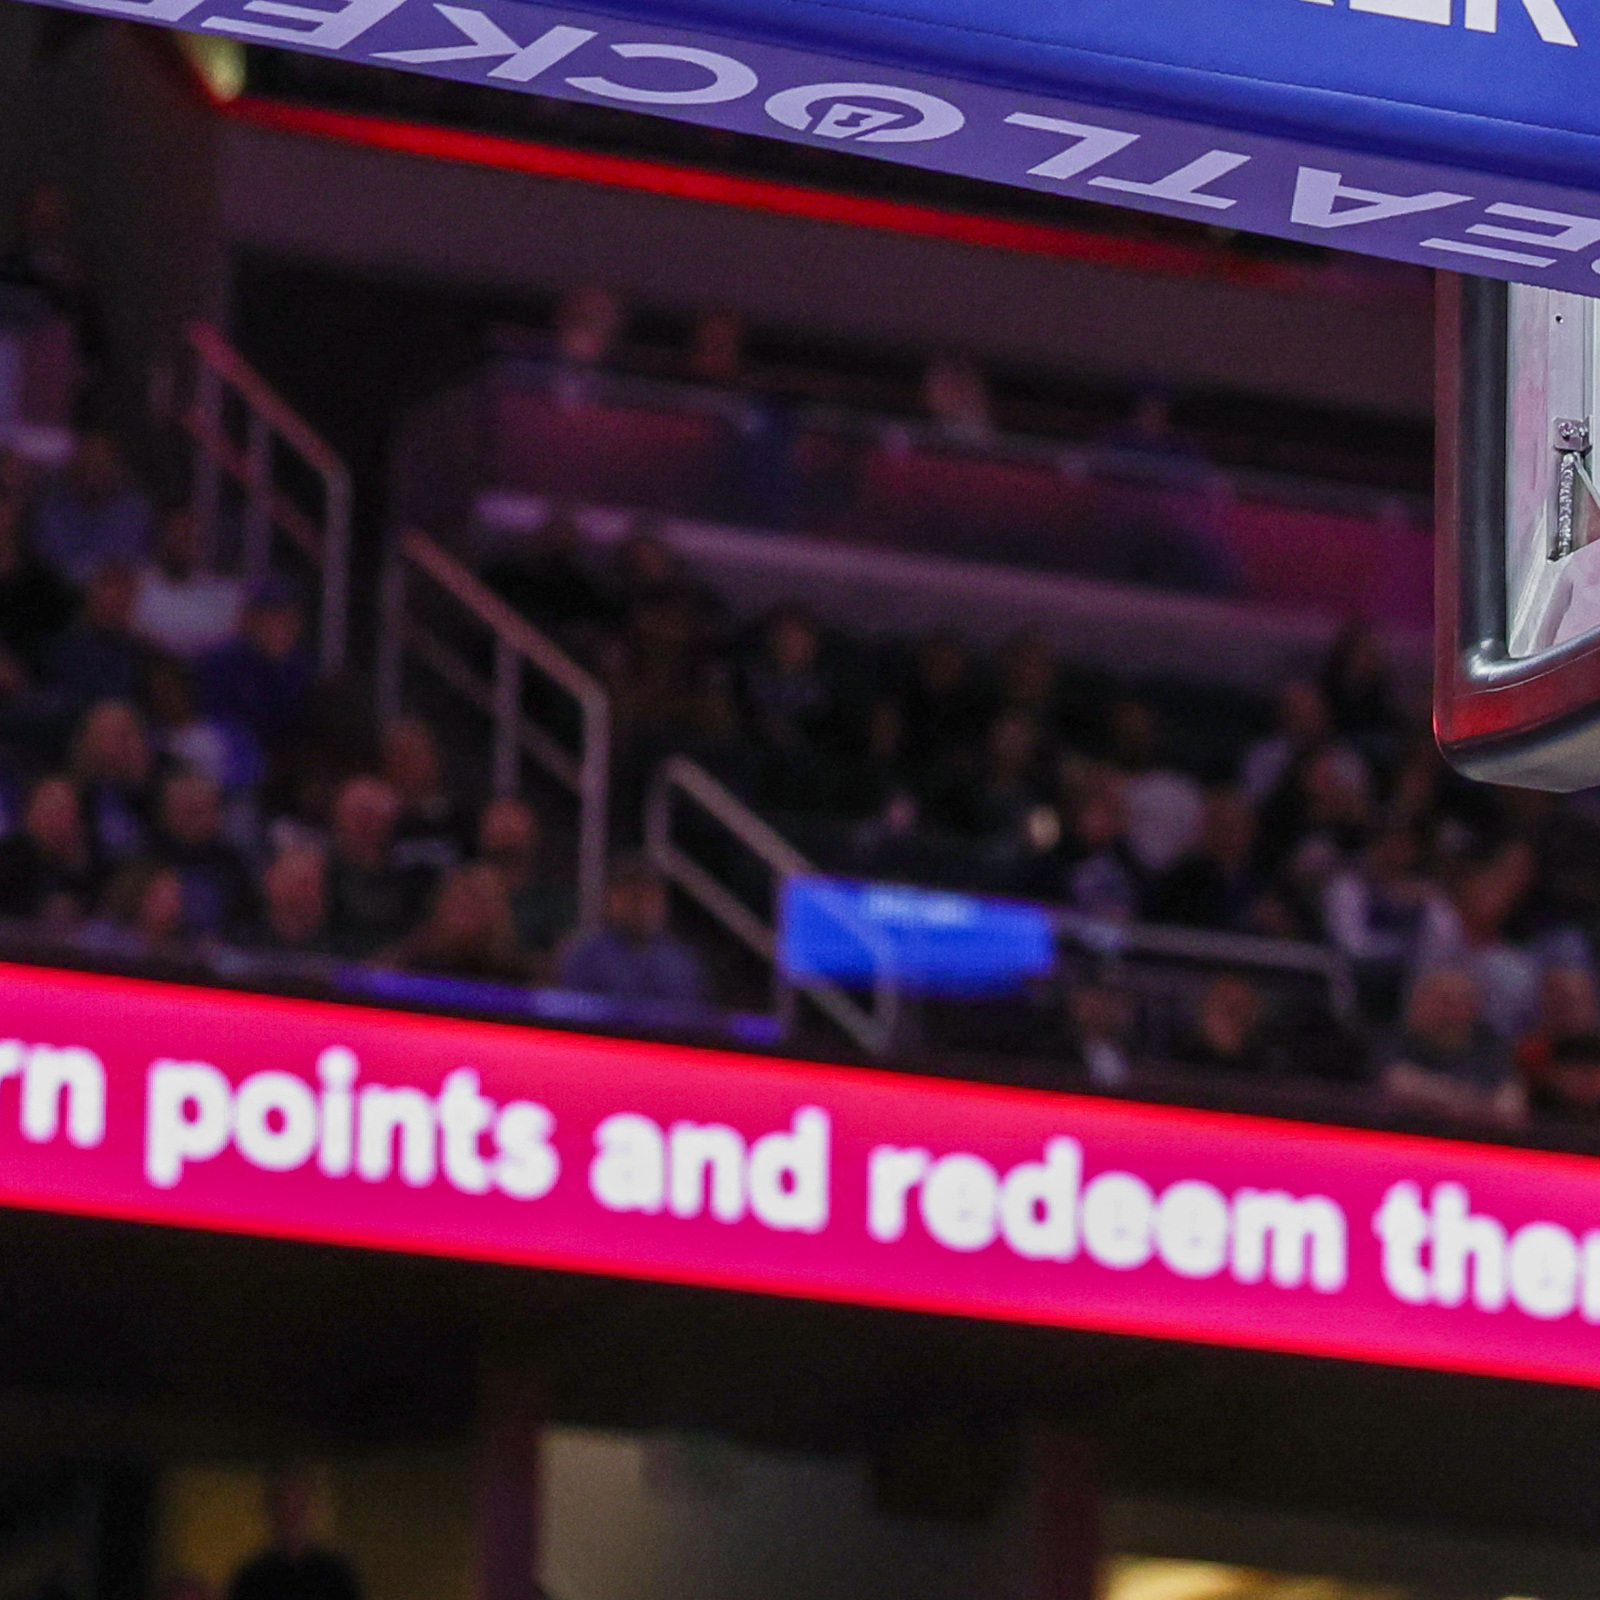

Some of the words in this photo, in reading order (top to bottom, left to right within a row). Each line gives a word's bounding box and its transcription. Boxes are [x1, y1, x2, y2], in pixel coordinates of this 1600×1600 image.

[144, 1044, 561, 1202] points
[588, 1103, 832, 1234] and
[866, 1135, 1348, 1293] redeem
